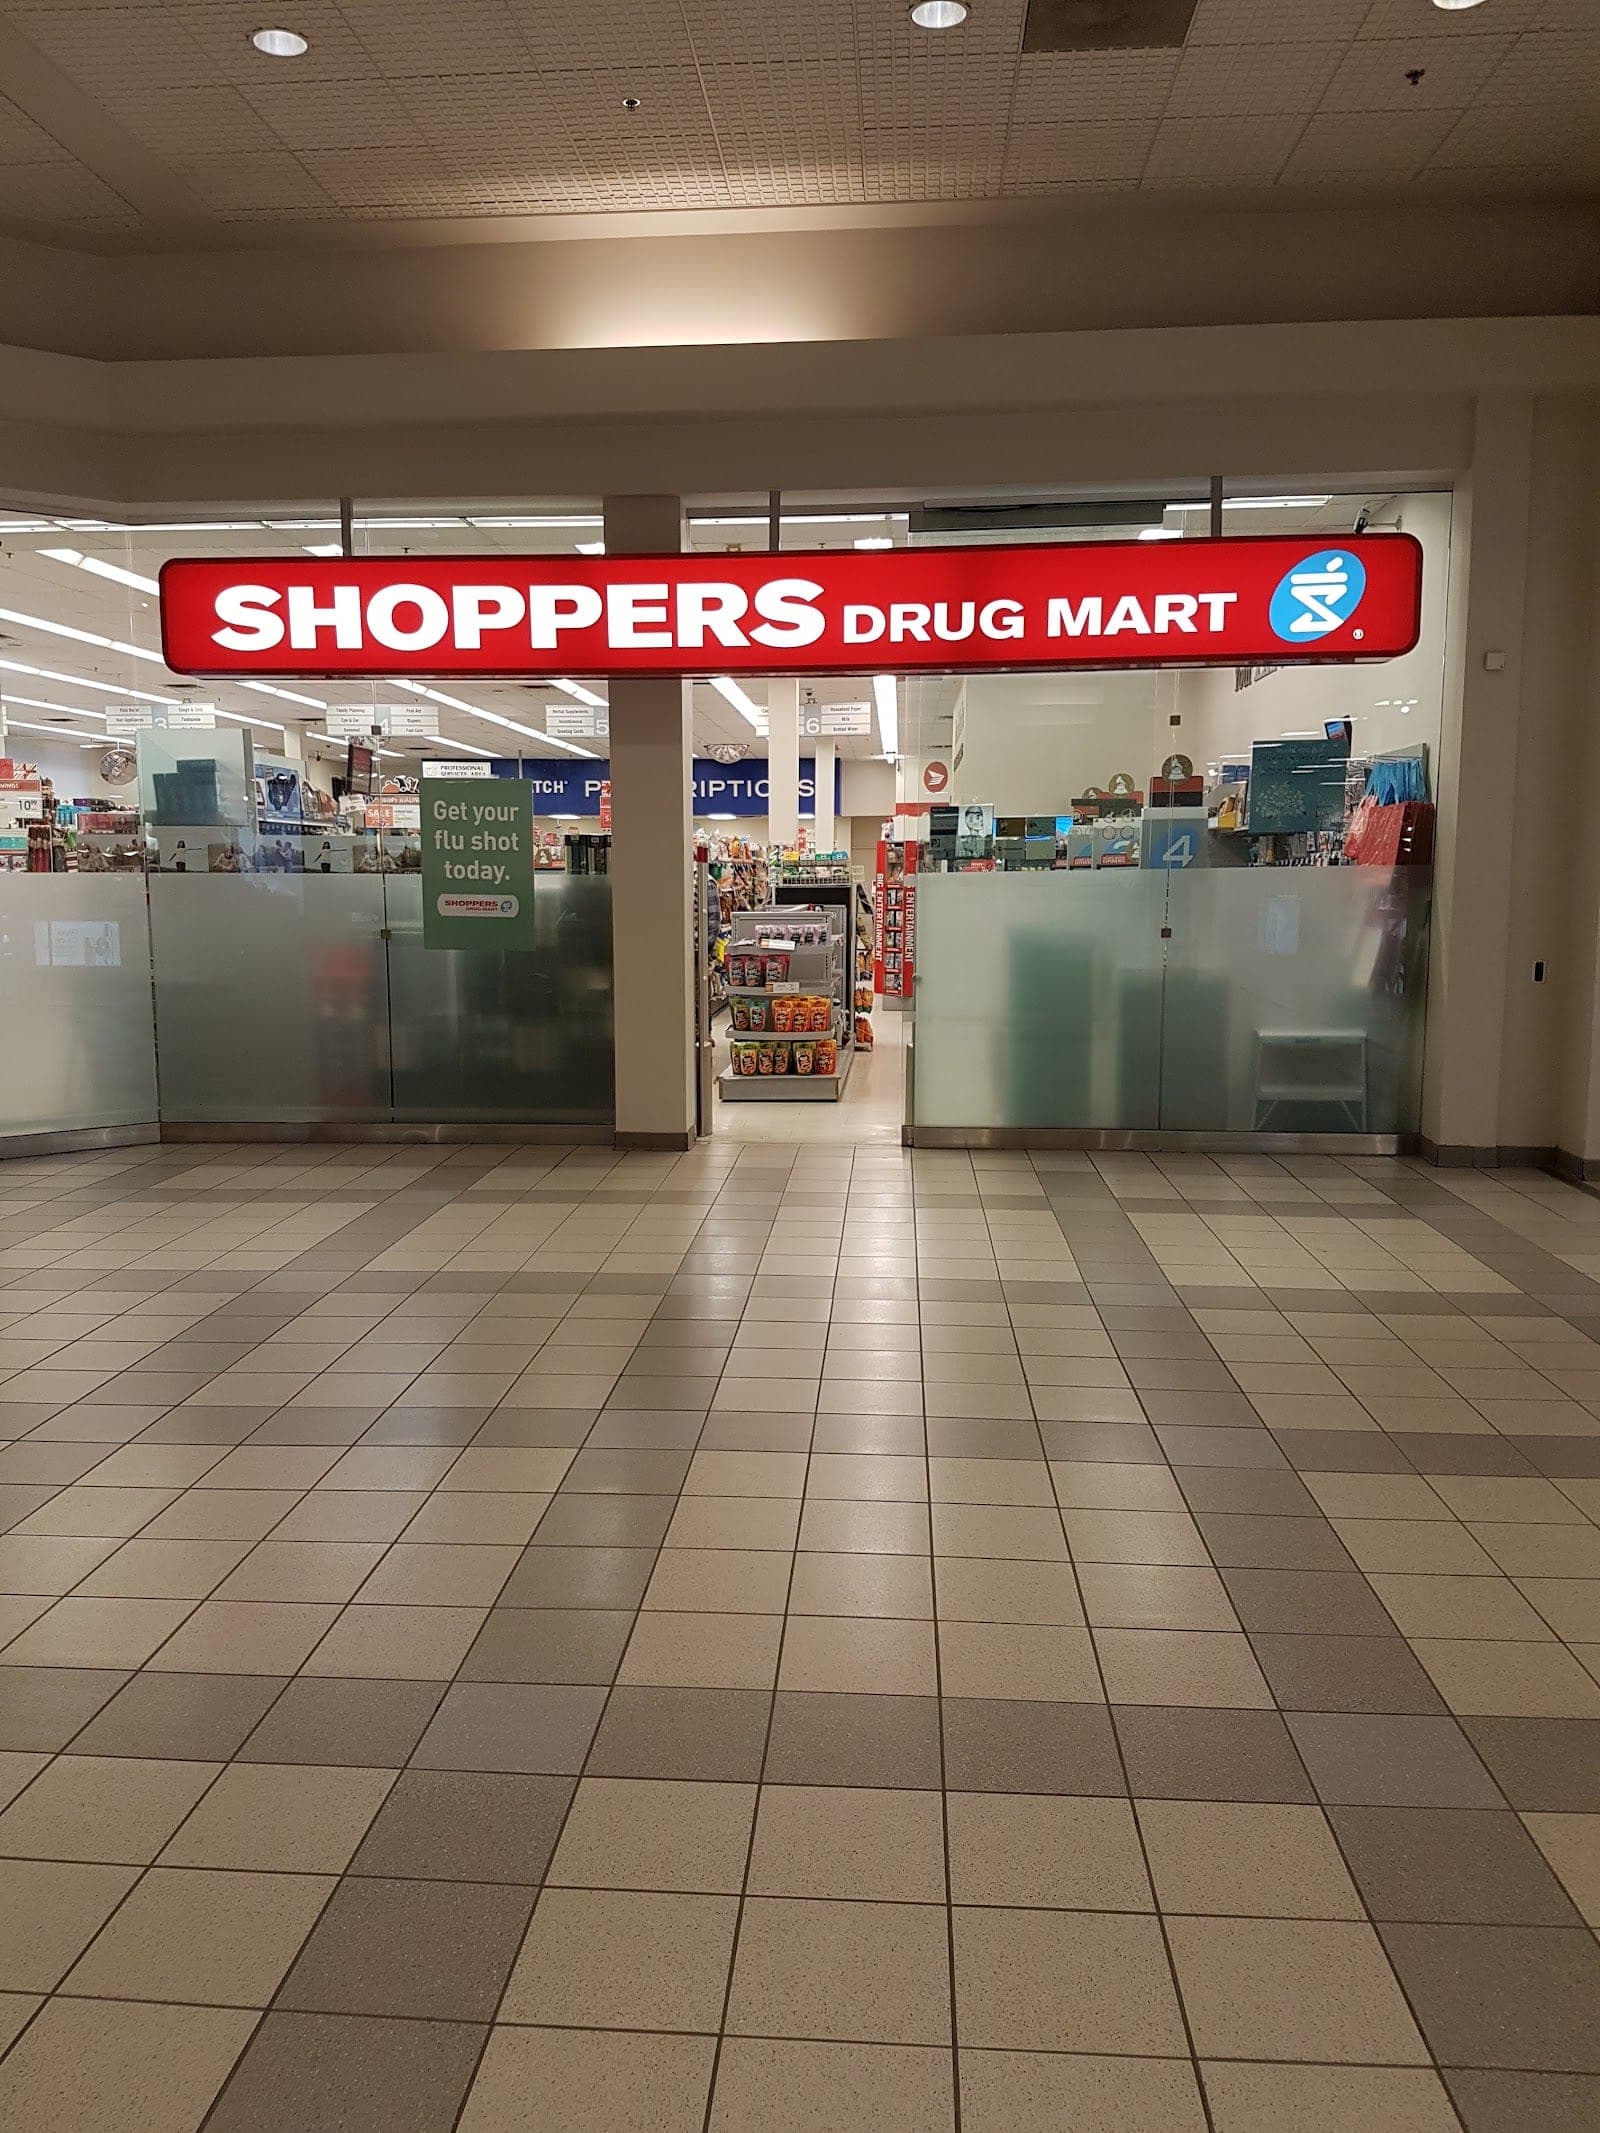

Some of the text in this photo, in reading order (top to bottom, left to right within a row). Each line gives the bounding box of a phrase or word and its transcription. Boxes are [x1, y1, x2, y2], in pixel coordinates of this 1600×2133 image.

[211, 578, 826, 651] SHOPPERS
[843, 599, 1025, 643] DRUG
[1047, 592, 1238, 638] MART
[380, 718, 391, 735] 4
[596, 719, 609, 735] 5
[806, 717, 820, 734] 6
[433, 800, 468, 821] Get
[472, 805, 520, 826] your
[434, 829, 520, 851] flu shot
[444, 859, 510, 885] today.
[875, 873, 885, 962] BIG ENTERTAINMENT
[904, 891, 915, 963] ENTERTAINMENT
